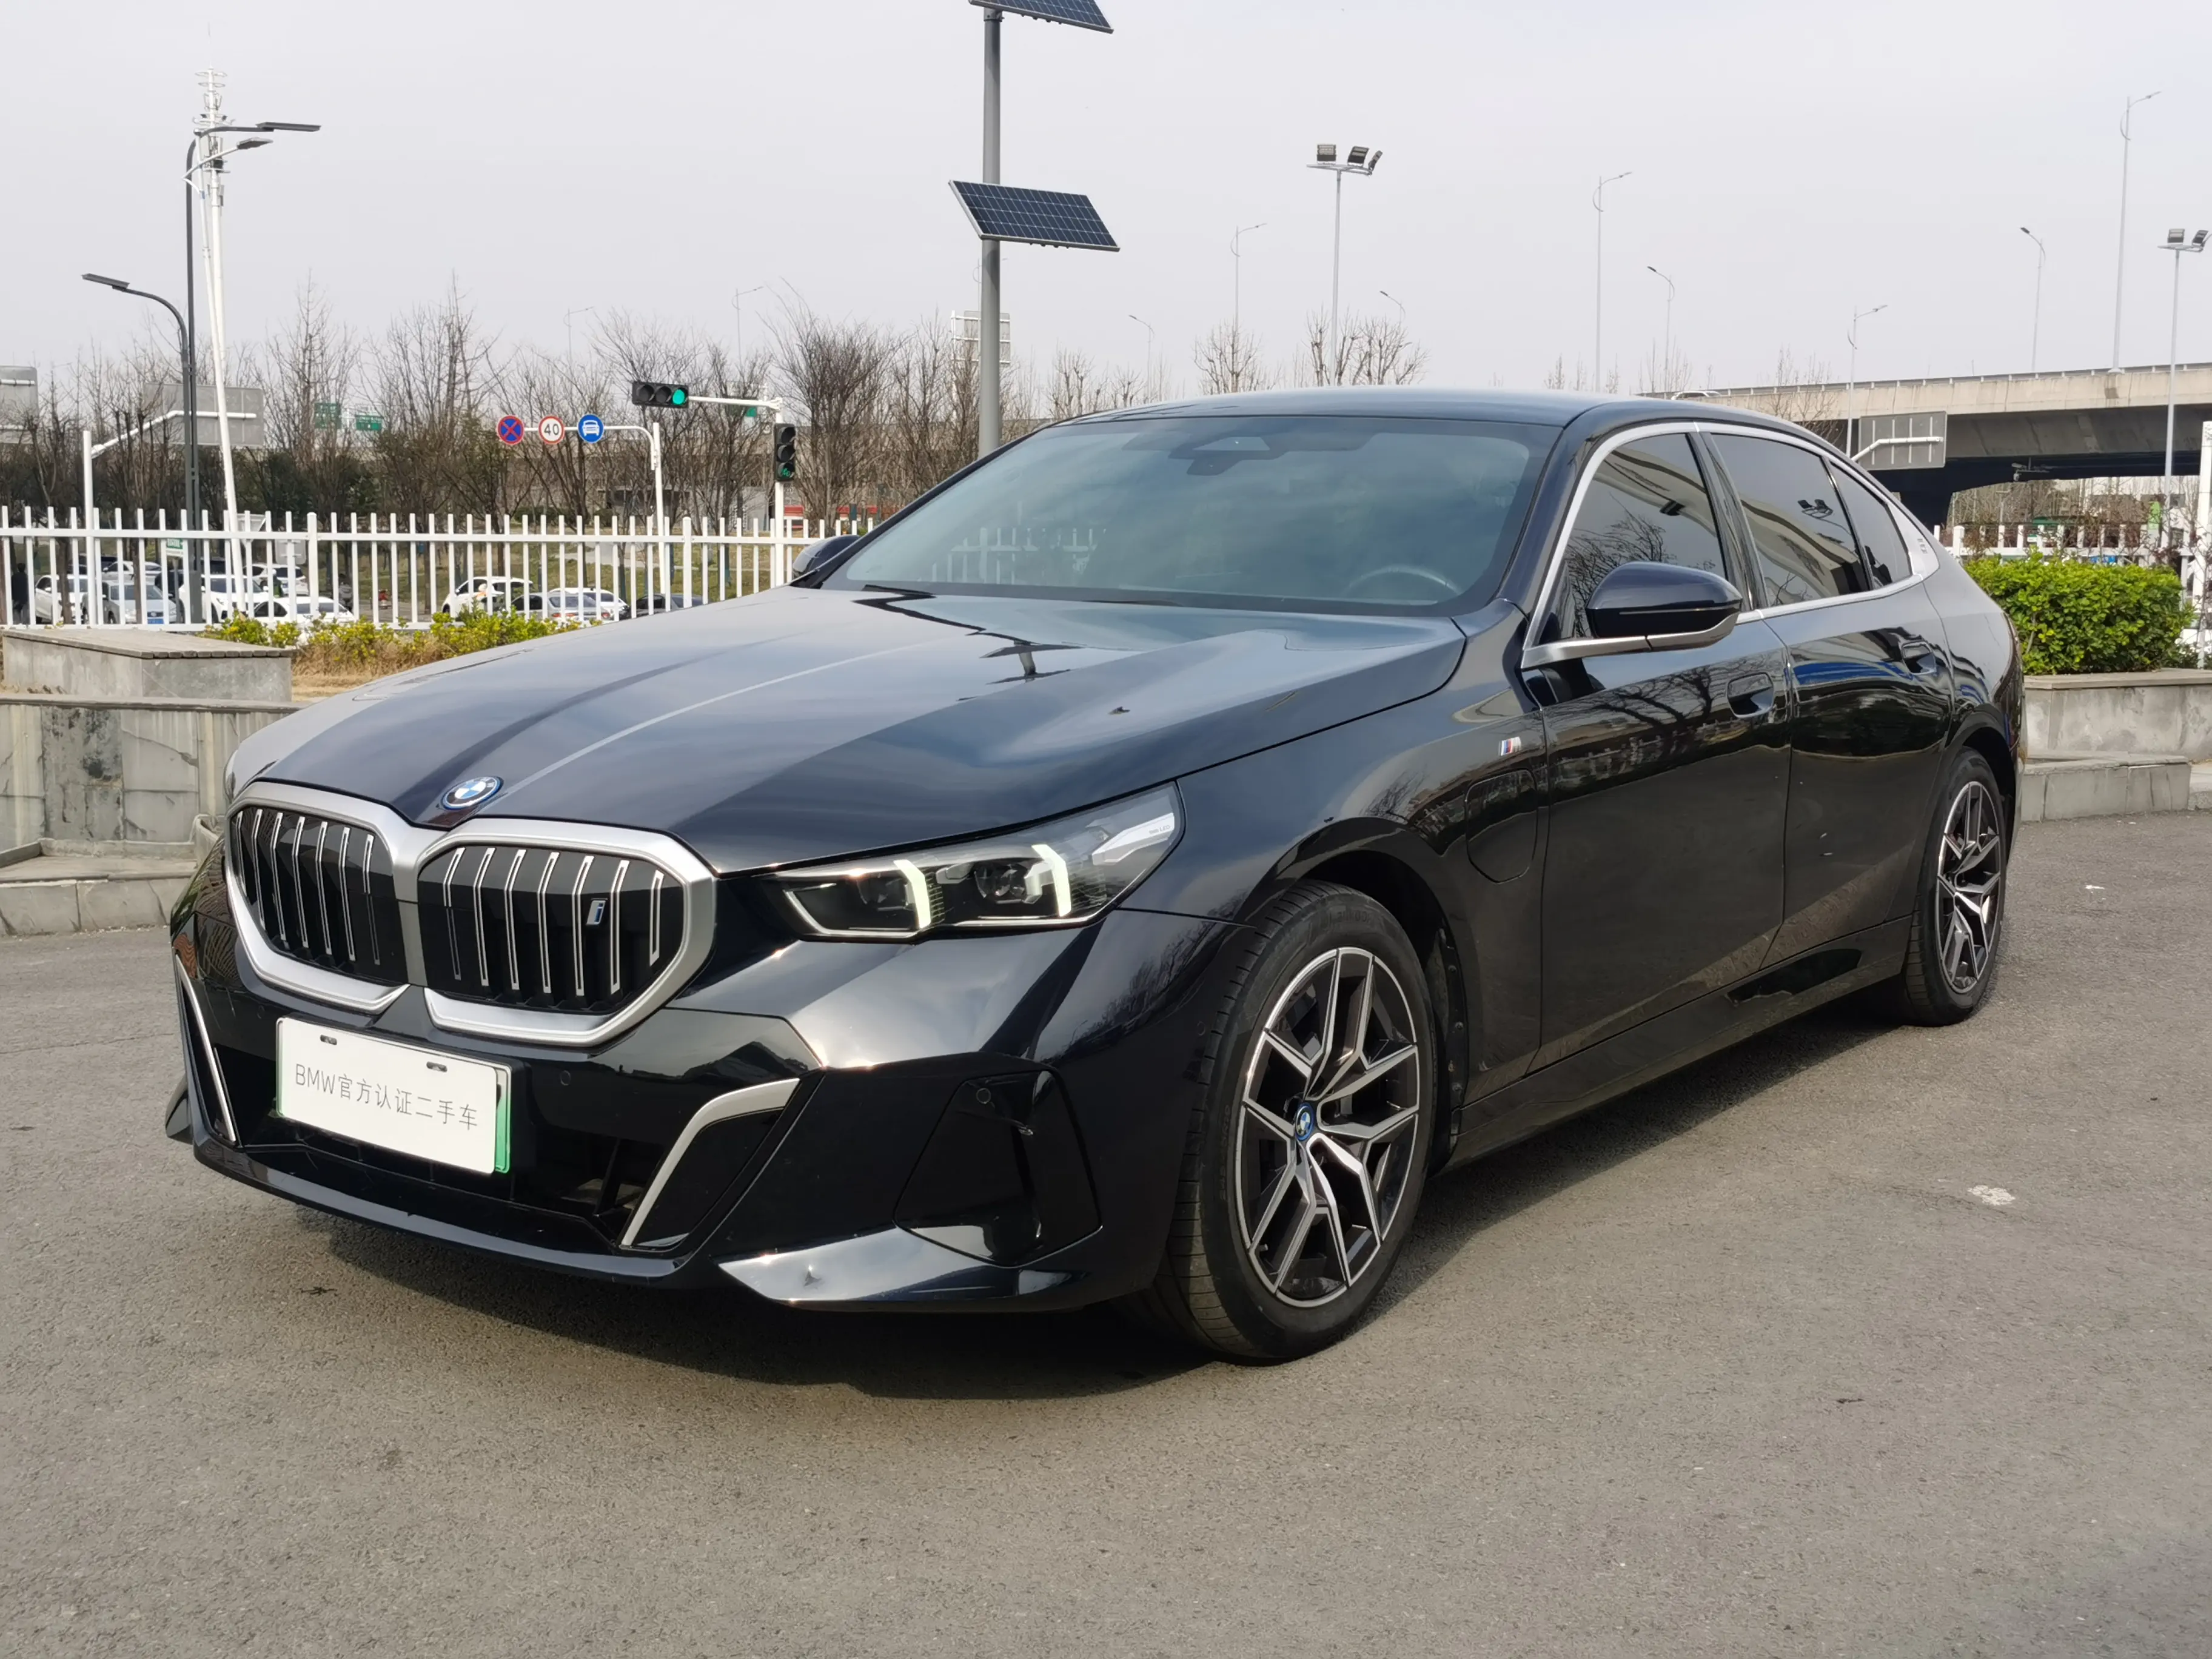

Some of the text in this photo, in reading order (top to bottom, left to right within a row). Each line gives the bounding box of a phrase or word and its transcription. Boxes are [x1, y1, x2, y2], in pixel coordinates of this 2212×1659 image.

[544, 423, 560, 436] 40
[295, 1063, 478, 1131] BMW官方认证二手车
